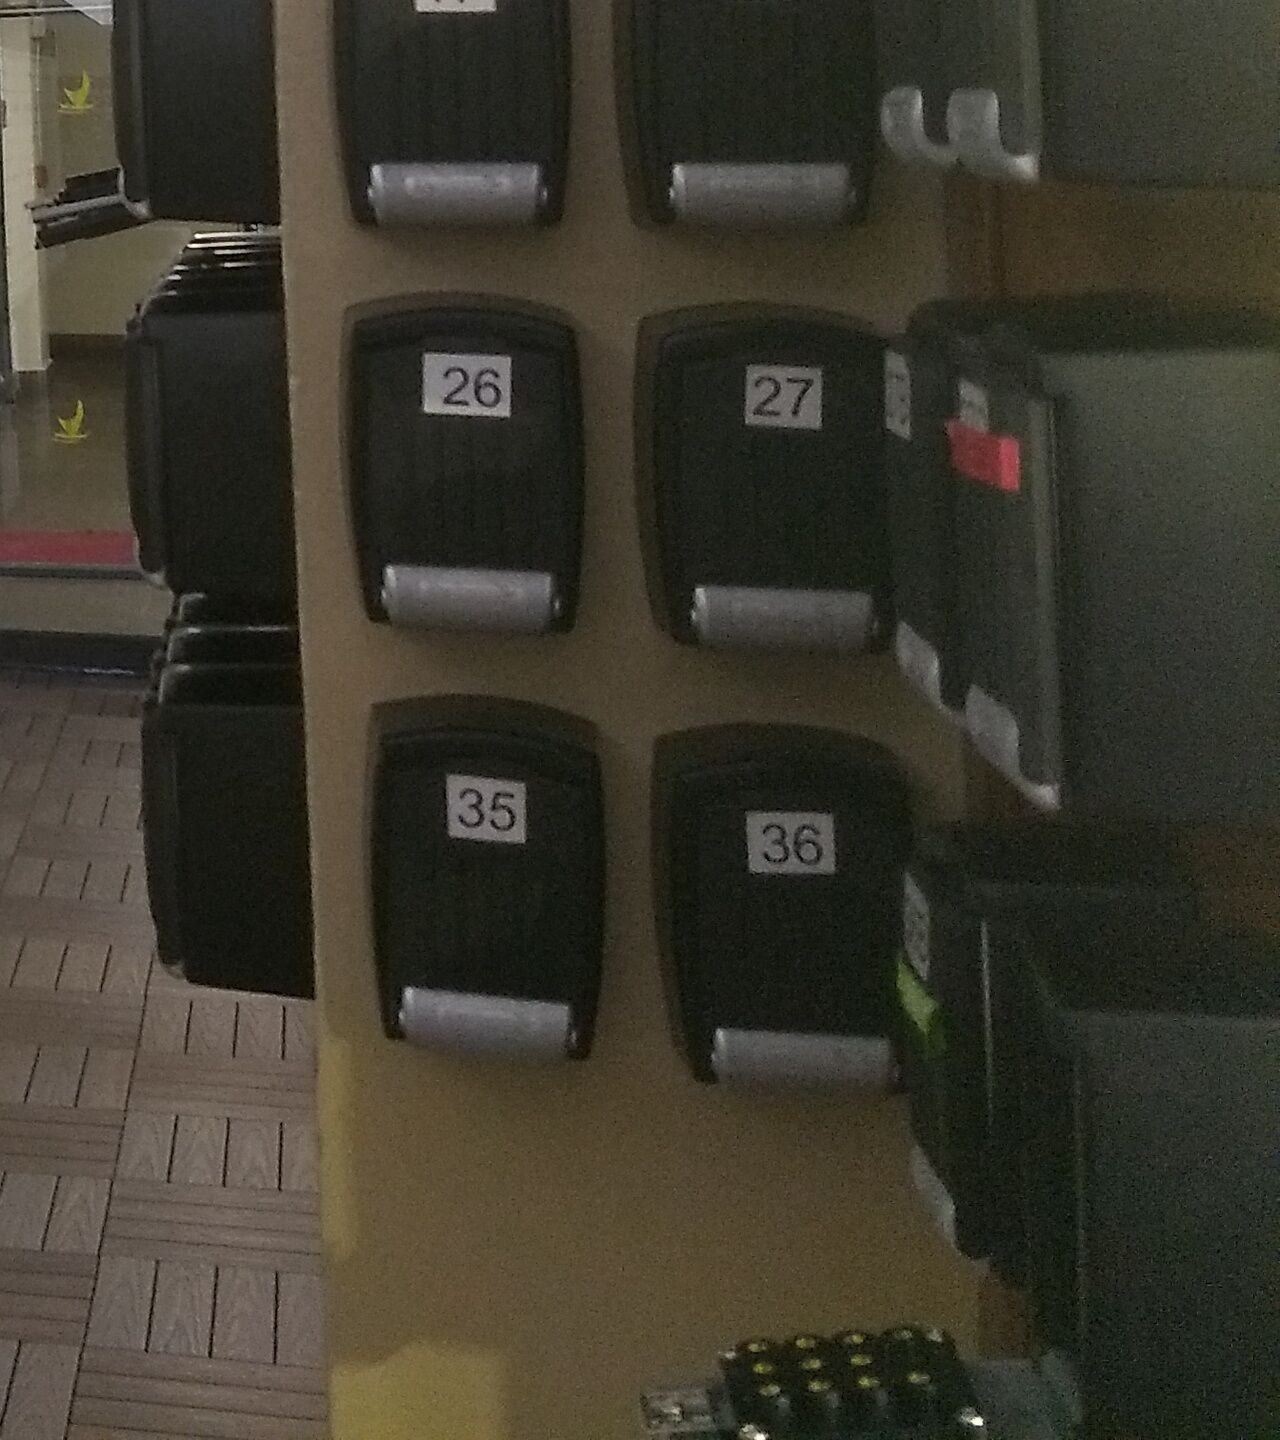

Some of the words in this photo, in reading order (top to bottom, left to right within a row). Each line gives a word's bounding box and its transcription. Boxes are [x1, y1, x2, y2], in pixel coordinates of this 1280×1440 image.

[442, 366, 503, 408] 26
[752, 375, 815, 418] 27
[457, 787, 517, 832] 35
[761, 823, 824, 866] 36
